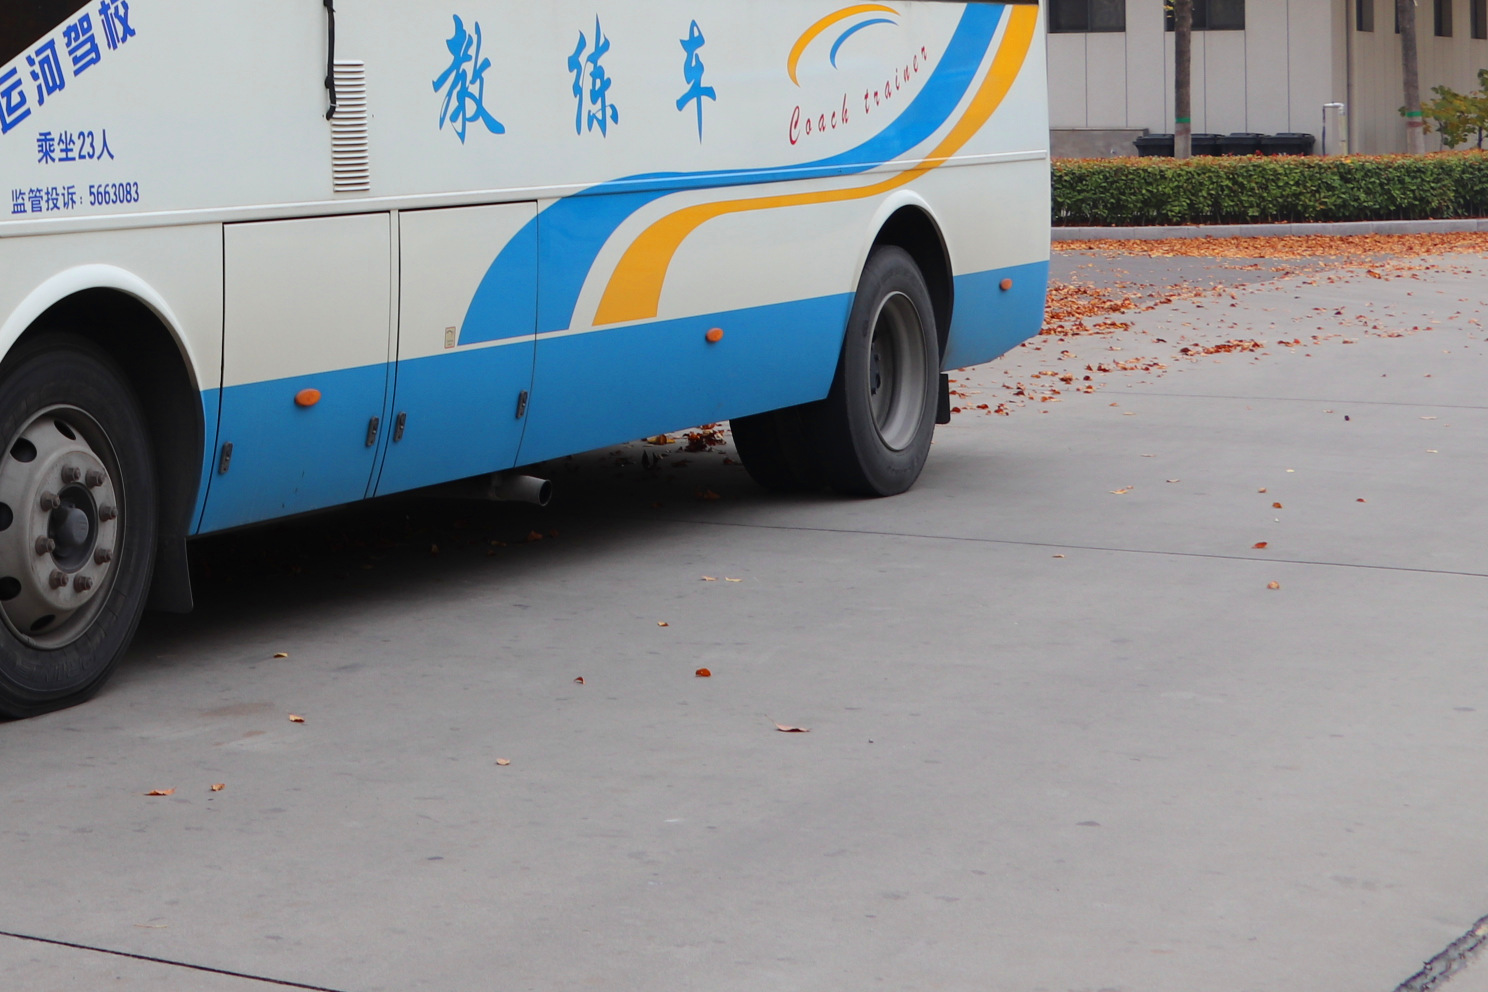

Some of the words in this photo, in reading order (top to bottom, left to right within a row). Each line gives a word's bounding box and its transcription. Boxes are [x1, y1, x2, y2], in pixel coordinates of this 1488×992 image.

[432, 12, 716, 145] 教练车
[789, 93, 849, 145] Coach
[864, 45, 927, 114] trainer
[36, 129, 114, 164] 乘坐23人
